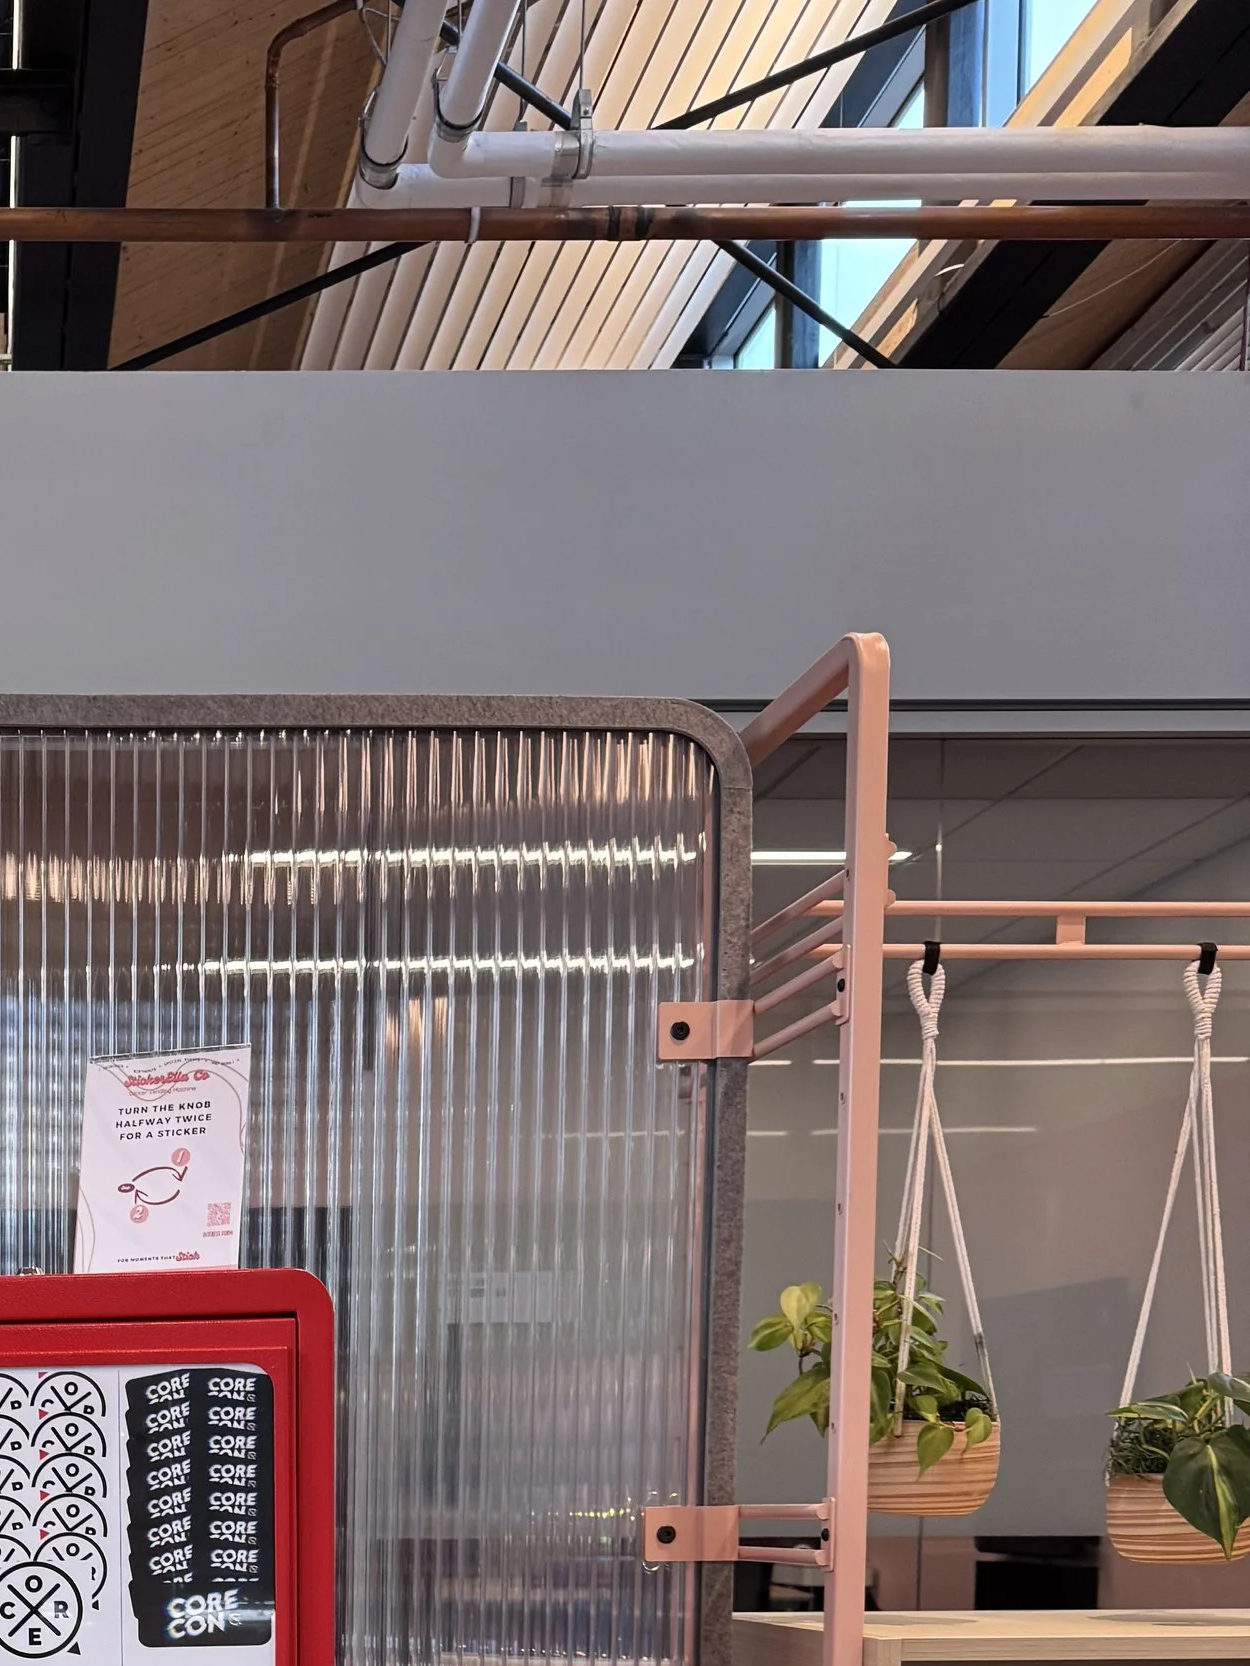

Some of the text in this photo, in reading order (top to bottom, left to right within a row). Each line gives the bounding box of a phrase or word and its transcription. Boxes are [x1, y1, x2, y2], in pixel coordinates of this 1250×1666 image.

[193, 1068, 210, 1083] Co
[118, 1100, 212, 1115] TURN THE KNOB
[115, 1113, 212, 1129] HALFWAY TWICE
[119, 1127, 207, 1141] FOR A STICKER
[146, 1373, 190, 1399] CORE
[208, 1378, 257, 1392] CORE
[146, 1401, 190, 1428] CORE
[208, 1406, 257, 1420] CORE
[147, 1430, 191, 1457] CORE
[208, 1435, 257, 1449] CORE
[146, 1459, 190, 1485] CORE
[209, 1464, 258, 1478] CORE
[147, 1487, 191, 1514] CORE
[209, 1492, 258, 1506] CORE
[147, 1515, 191, 1542] CORE
[209, 1521, 258, 1534] CORE
[149, 1544, 193, 1571] CORE
[210, 1549, 259, 1563] CORE
[167, 1588, 240, 1619] CORE
[167, 1611, 226, 1639] CON
